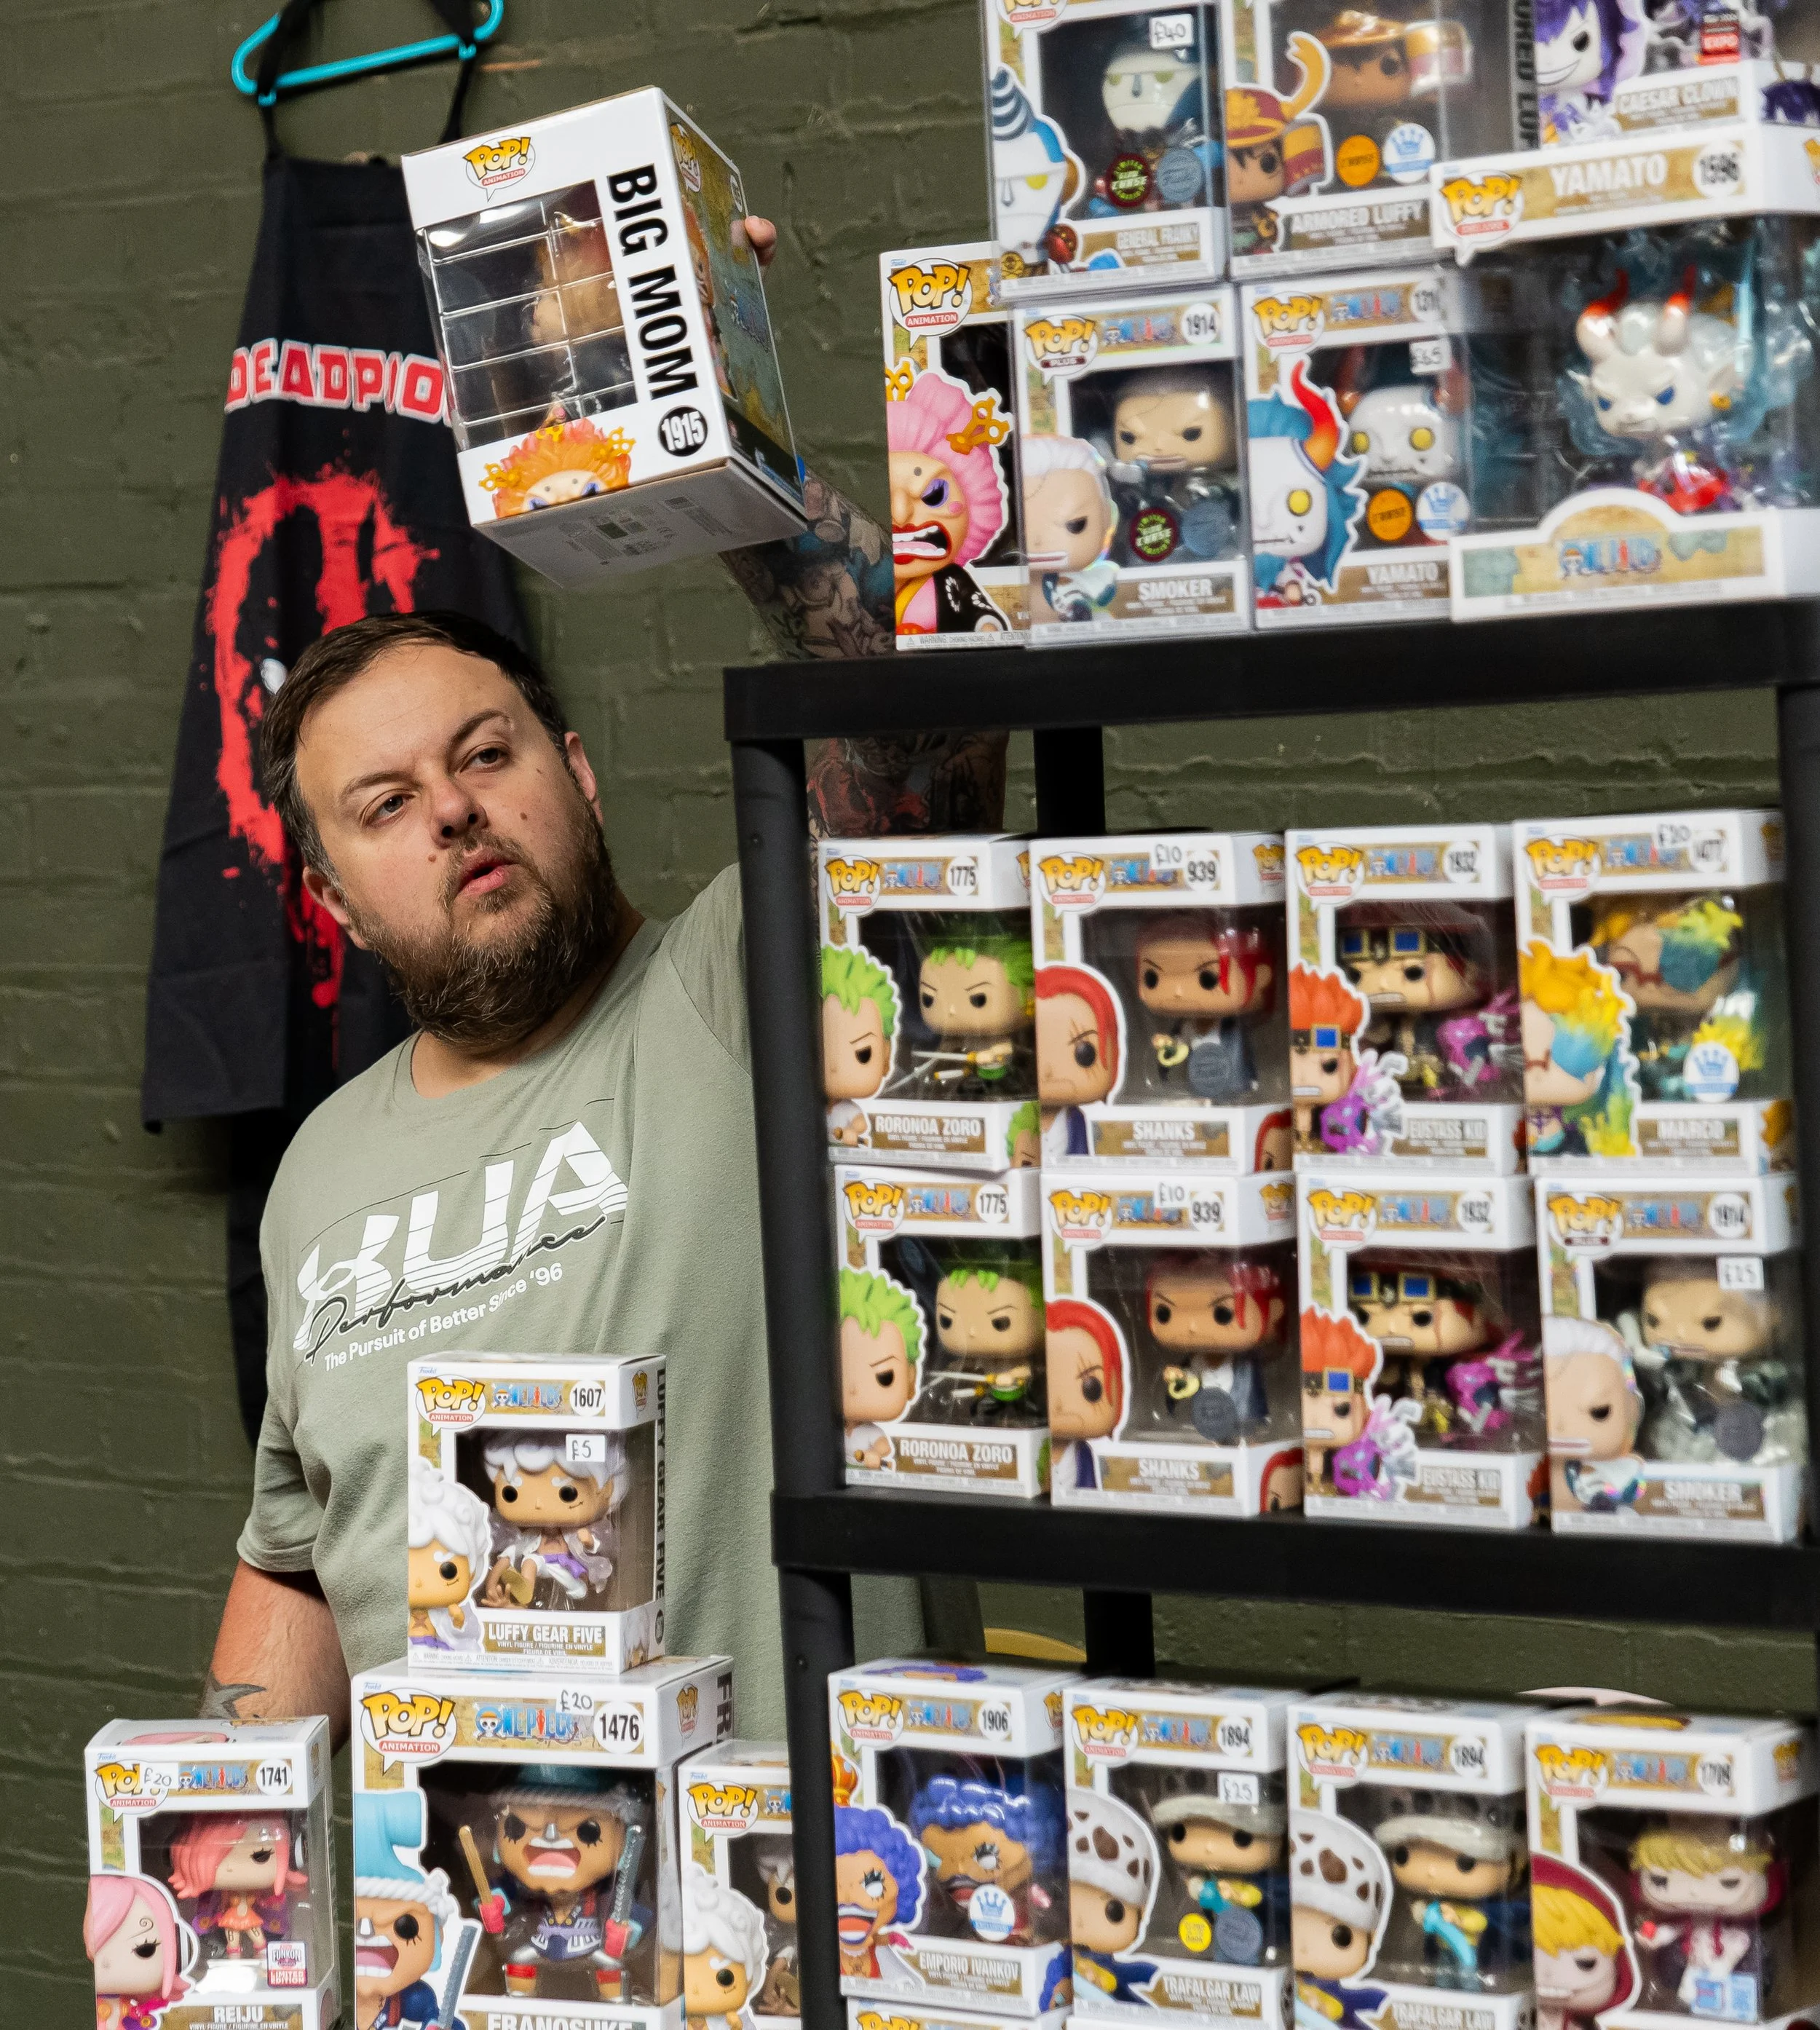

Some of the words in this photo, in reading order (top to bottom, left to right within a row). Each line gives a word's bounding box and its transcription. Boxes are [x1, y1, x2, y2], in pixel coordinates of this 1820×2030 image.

[1155, 20, 1186, 43] £40
[462, 136, 532, 181] POP!
[482, 168, 525, 186] ANIMATION
[1550, 154, 1669, 197] YAMATO
[606, 163, 670, 257] BIG
[1439, 175, 1523, 226] POP!
[887, 264, 972, 316] POP!
[907, 314, 957, 326] ANIMATION
[1186, 313, 1216, 336] 1914
[1251, 295, 1324, 338] POP!
[627, 264, 699, 401] MOM
[1023, 319, 1096, 360] POP!
[660, 411, 706, 452] 1915
[1366, 562, 1439, 584] YAMATO
[1139, 578, 1213, 600] SMOKER
[1154, 843, 1182, 866] £10
[1295, 846, 1364, 885] POP!
[1524, 839, 1600, 877] POP!
[824, 858, 880, 896] POP!
[950, 864, 977, 887] 1775
[1037, 856, 1104, 894] POP!
[1187, 860, 1216, 882] 939
[876, 1115, 939, 1134] RORONOA
[942, 1118, 981, 1137] ZORO
[1133, 1121, 1195, 1140] SHANKS
[843, 1181, 903, 1218] POP!
[979, 1193, 1007, 1215] 1775
[1159, 1182, 1184, 1204] £10
[1049, 1190, 1112, 1227] POP!
[1192, 1201, 1222, 1224] 939
[1307, 1189, 1376, 1228] POP!
[1548, 1195, 1621, 1234] POP!
[306, 1215, 606, 1364] Performance
[325, 1351, 347, 1371] The
[349, 1328, 406, 1360] Pursuit
[408, 1319, 427, 1340] of
[430, 1303, 486, 1334] Better
[488, 1279, 527, 1312] Since
[529, 1262, 563, 1286] '96
[416, 1377, 486, 1413] POP!
[573, 1388, 603, 1410] 1607
[430, 1413, 472, 1421] ANIMATION
[571, 1439, 592, 1461] £5
[900, 1439, 970, 1461] RORONOA
[973, 1445, 1013, 1464] ZORO
[1139, 1458, 1200, 1480] SHANKS
[1664, 1480, 1744, 1502] SMOKER
[488, 1623, 529, 1641] LUFFY
[532, 1625, 570, 1643] GEAR
[573, 1627, 603, 1644] FIVE
[560, 1689, 593, 1713] £20
[837, 1690, 903, 1729] POP!
[360, 1691, 456, 1741] POP!
[599, 1713, 639, 1742] 1476
[983, 1709, 1008, 1731] 1906
[1072, 1704, 1138, 1745] POP!
[852, 1730, 892, 1741] ANIMATION
[1221, 1725, 1250, 1747] 1894
[1297, 1723, 1368, 1765] POP!
[381, 1743, 438, 1753] ANIMATION
[1535, 1744, 1607, 1785] POP!
[143, 1767, 173, 1787] £20
[261, 1766, 288, 1787] 1741
[111, 1798, 156, 1807] ANIMATION
[687, 1783, 758, 1819] POP!
[703, 1820, 745, 1828] ANIMATION
[272, 1949, 301, 1962] FUNKON
[919, 1951, 968, 1975] EMPORIO
[971, 1956, 1018, 1980] IVANKOV
[270, 1977, 304, 1985] EDITION
[213, 2005, 264, 2023] REIJU
